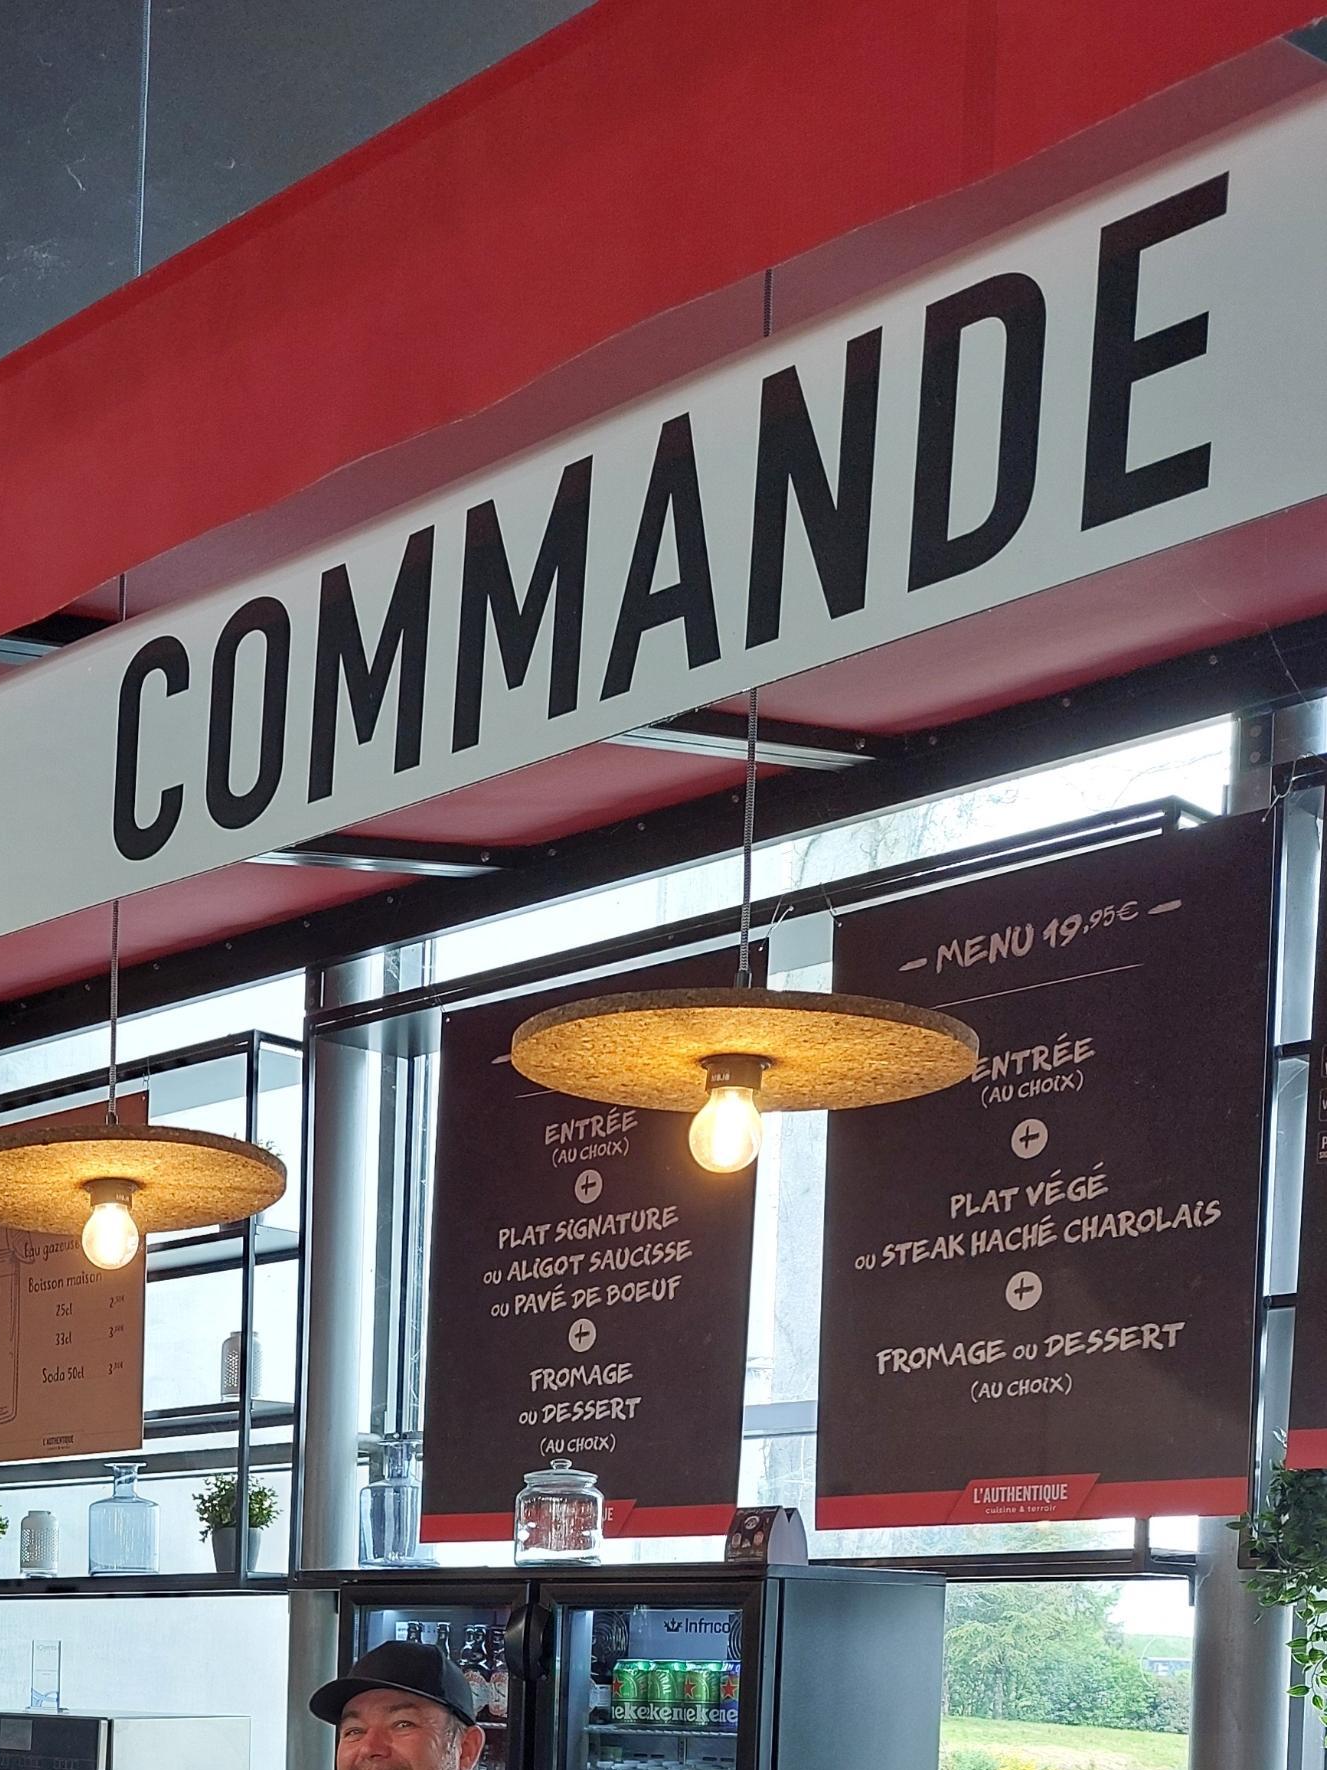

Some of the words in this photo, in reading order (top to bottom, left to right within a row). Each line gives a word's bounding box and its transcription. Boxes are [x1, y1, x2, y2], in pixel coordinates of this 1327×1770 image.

[110, 168, 1231, 863] COMMANDE
[935, 924, 1033, 974] MENU
[972, 1032, 1096, 1084] ENTRÉE
[544, 1106, 640, 1146] ENTRÉE
[950, 1187, 1020, 1220] PLAT
[1025, 1161, 1110, 1206] VÉGÉ
[499, 1220, 552, 1250] PLAT
[554, 1205, 681, 1244] SIGNATURE
[880, 1231, 967, 1269] STEAK
[970, 1214, 1060, 1257] HACHÉ
[1063, 1199, 1224, 1246] CHAROLAIS
[28, 1276, 65, 1293] Boisson
[66, 1270, 103, 1289] maison
[507, 1253, 584, 1284] ALIGOT
[588, 1237, 694, 1275] SAUCISSE
[513, 1283, 568, 1317] PAVÉ
[570, 1285, 603, 1311] DE
[605, 1274, 683, 1306] BOEUF
[875, 1337, 1008, 1376] FROMAGE
[1043, 1320, 1187, 1358] DESSERT
[42, 1366, 66, 1384] Soda
[67, 1365, 85, 1381] 50cl
[529, 1361, 635, 1392] FROMAGE
[541, 1396, 643, 1424] DESSERT
[972, 1482, 1069, 1505] L'AUTHENTIQUE
